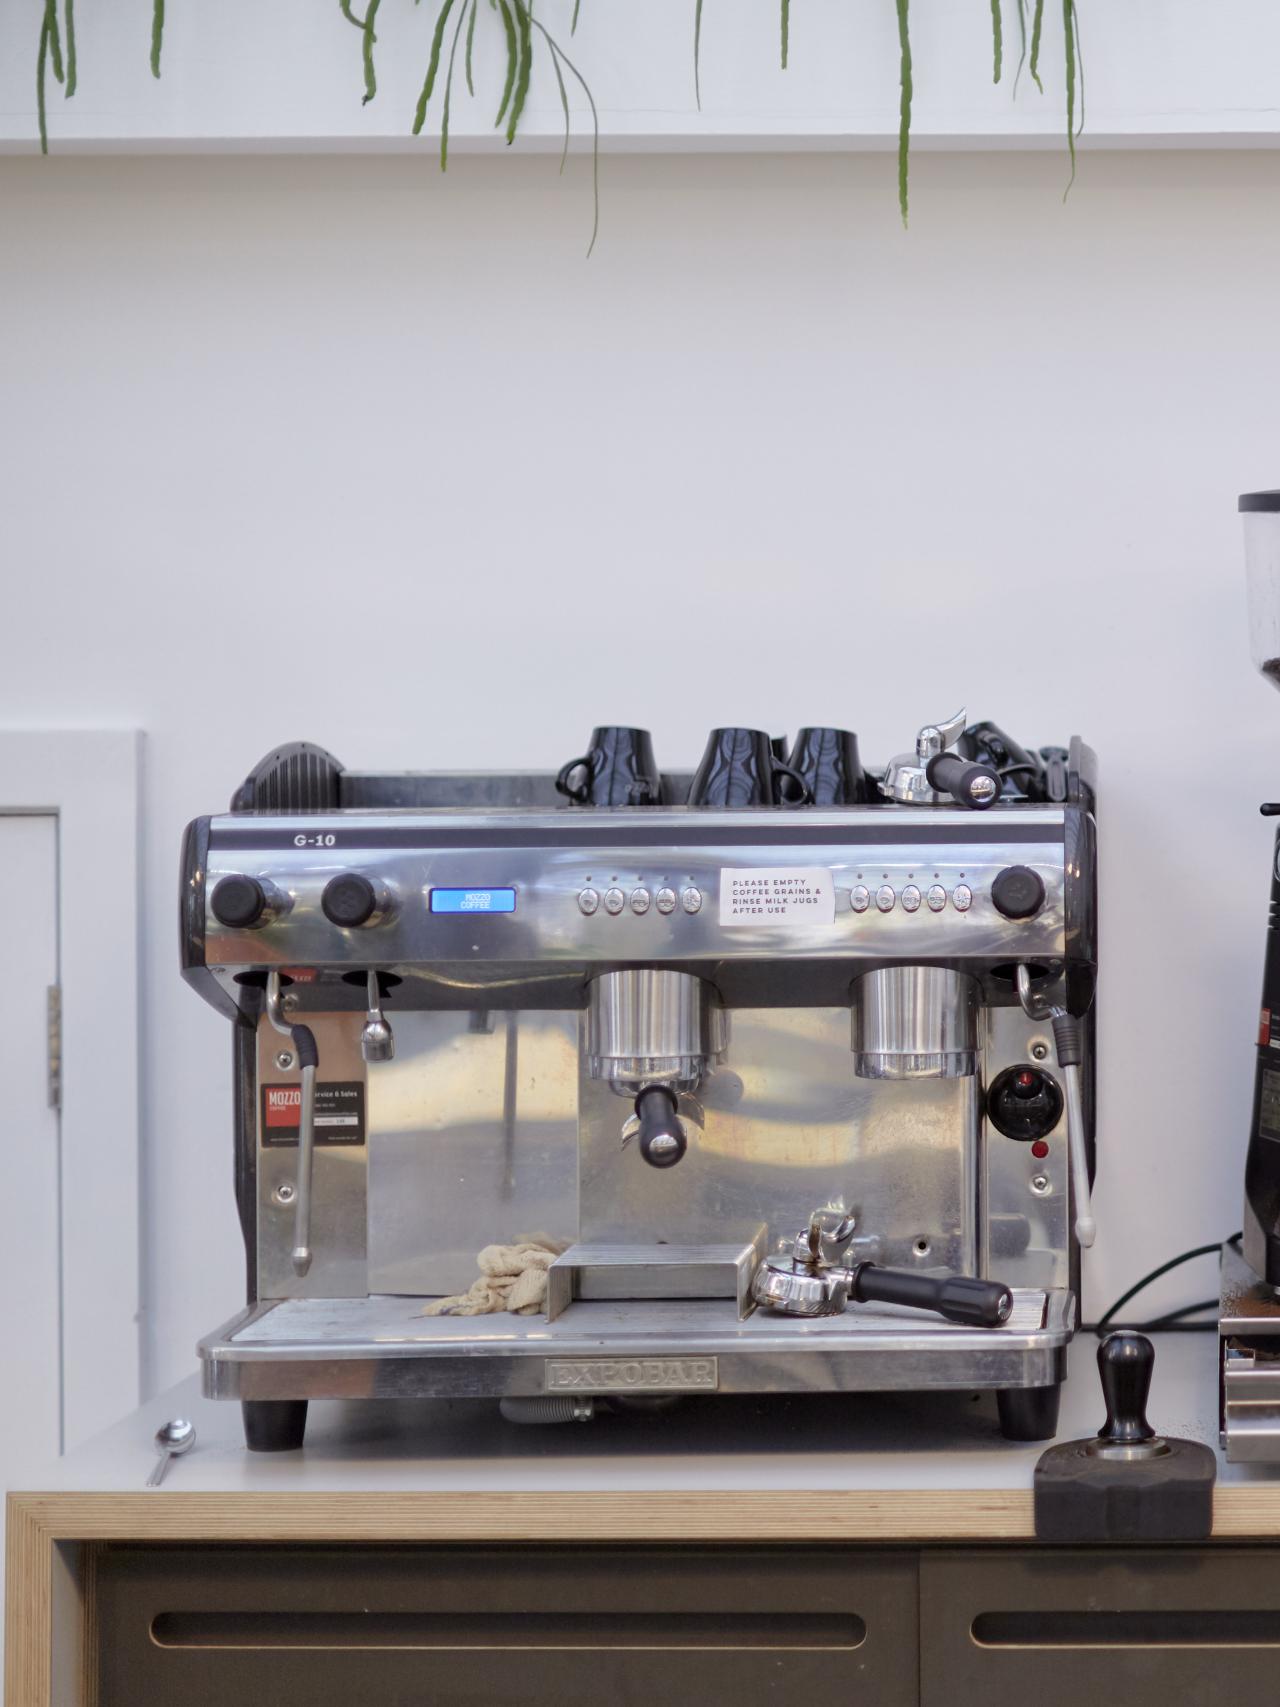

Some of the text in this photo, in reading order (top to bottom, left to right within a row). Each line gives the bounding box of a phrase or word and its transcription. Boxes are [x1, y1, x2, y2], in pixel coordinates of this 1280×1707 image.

[294, 834, 336, 847] G-10
[460, 901, 491, 909] COFFEE
[269, 1091, 301, 1105] MOZZO
[550, 1361, 714, 1387] EXPOBAR
